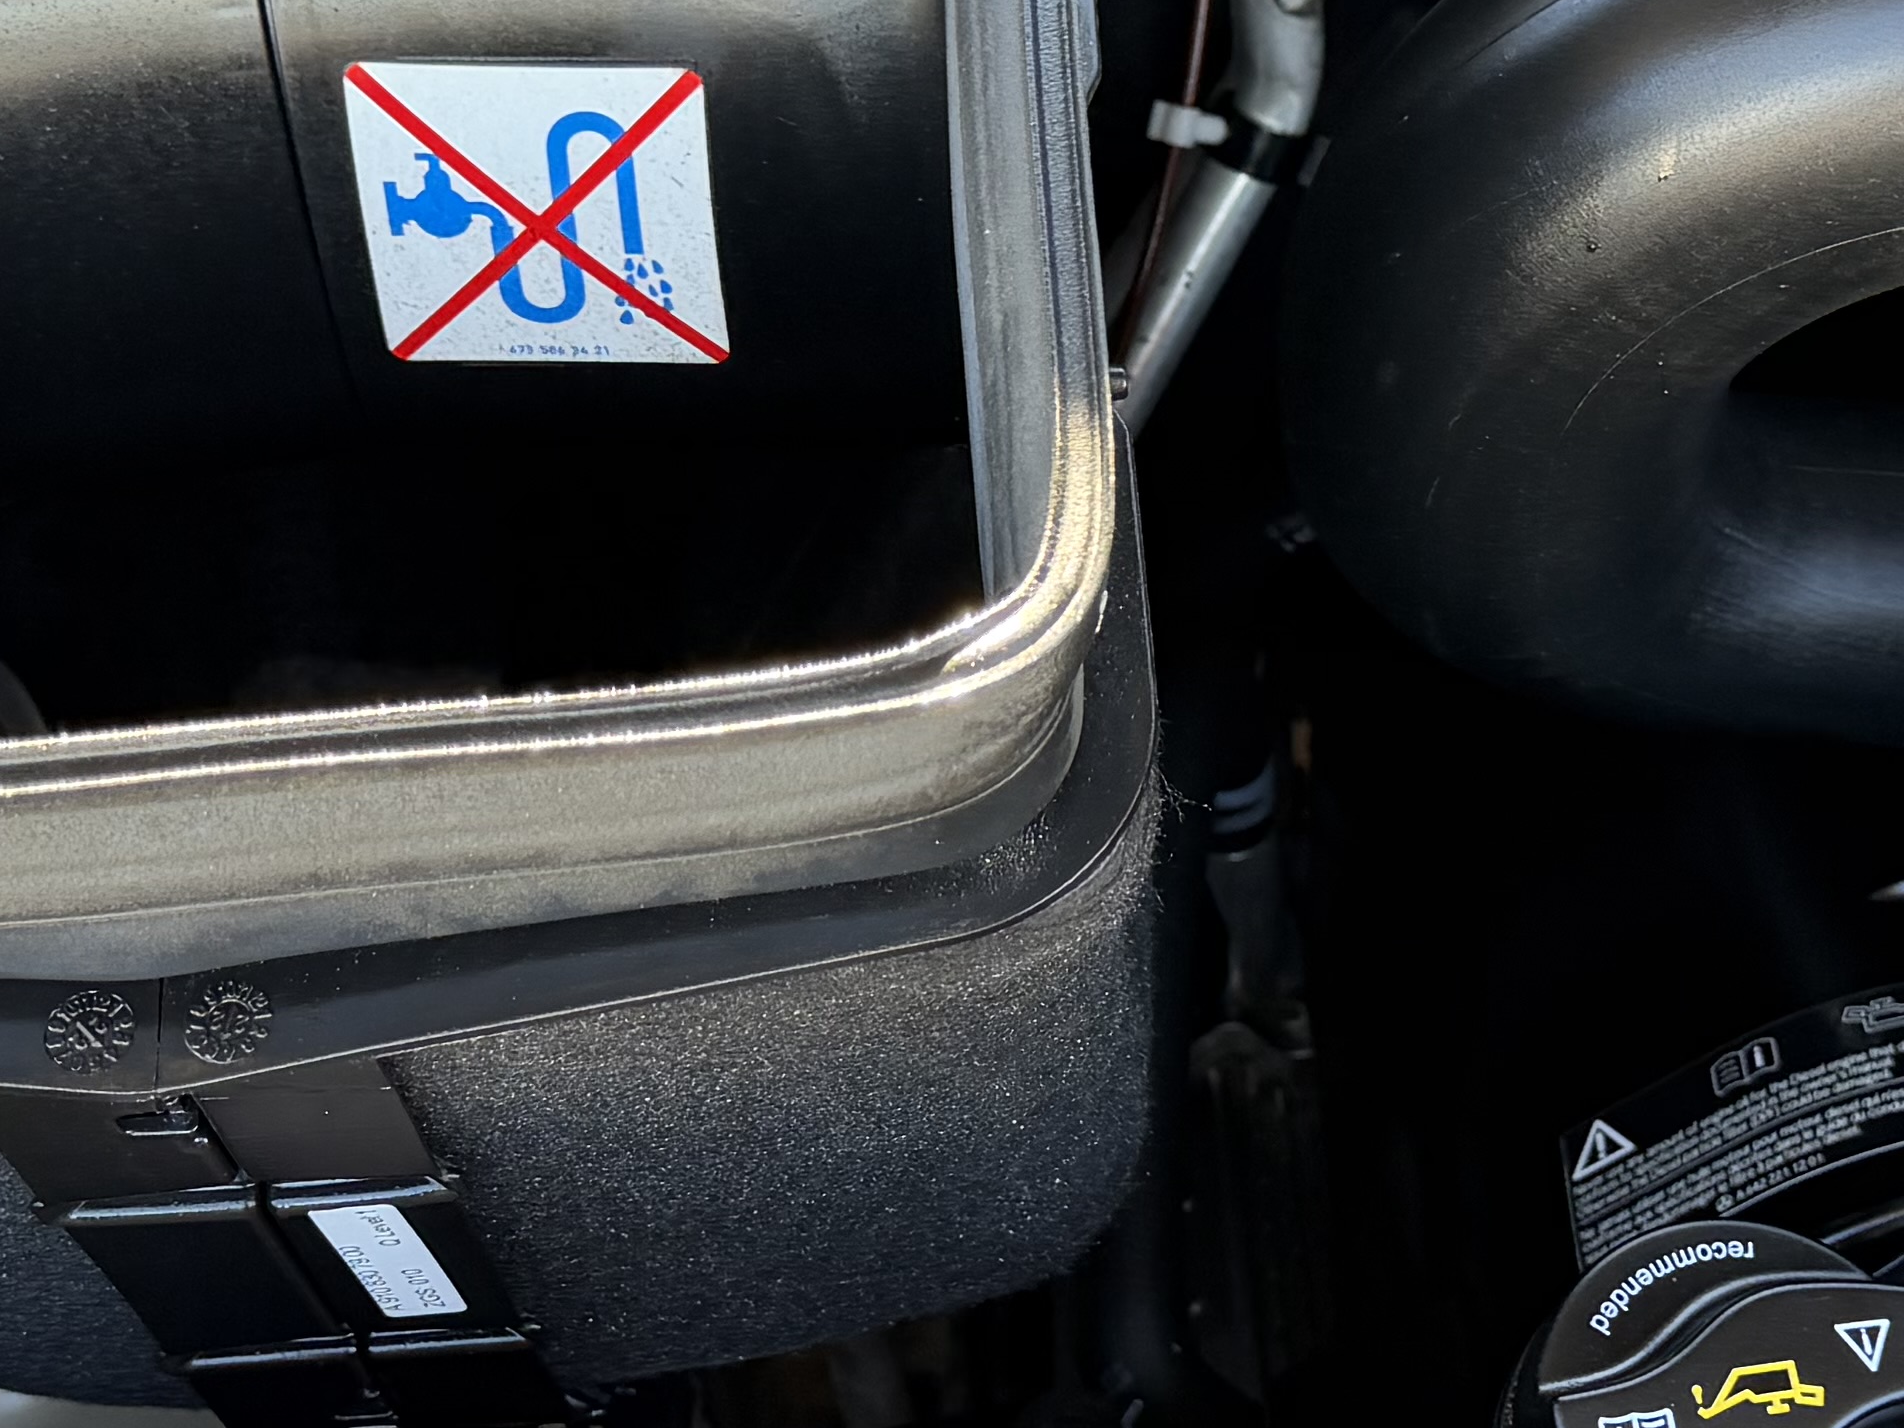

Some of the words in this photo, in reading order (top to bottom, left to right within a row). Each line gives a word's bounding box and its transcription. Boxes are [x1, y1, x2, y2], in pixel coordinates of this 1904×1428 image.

[1826, 1051, 1868, 1073] engine
[1868, 1043, 1896, 1059] that
[1589, 1239, 1756, 1336] recommended
